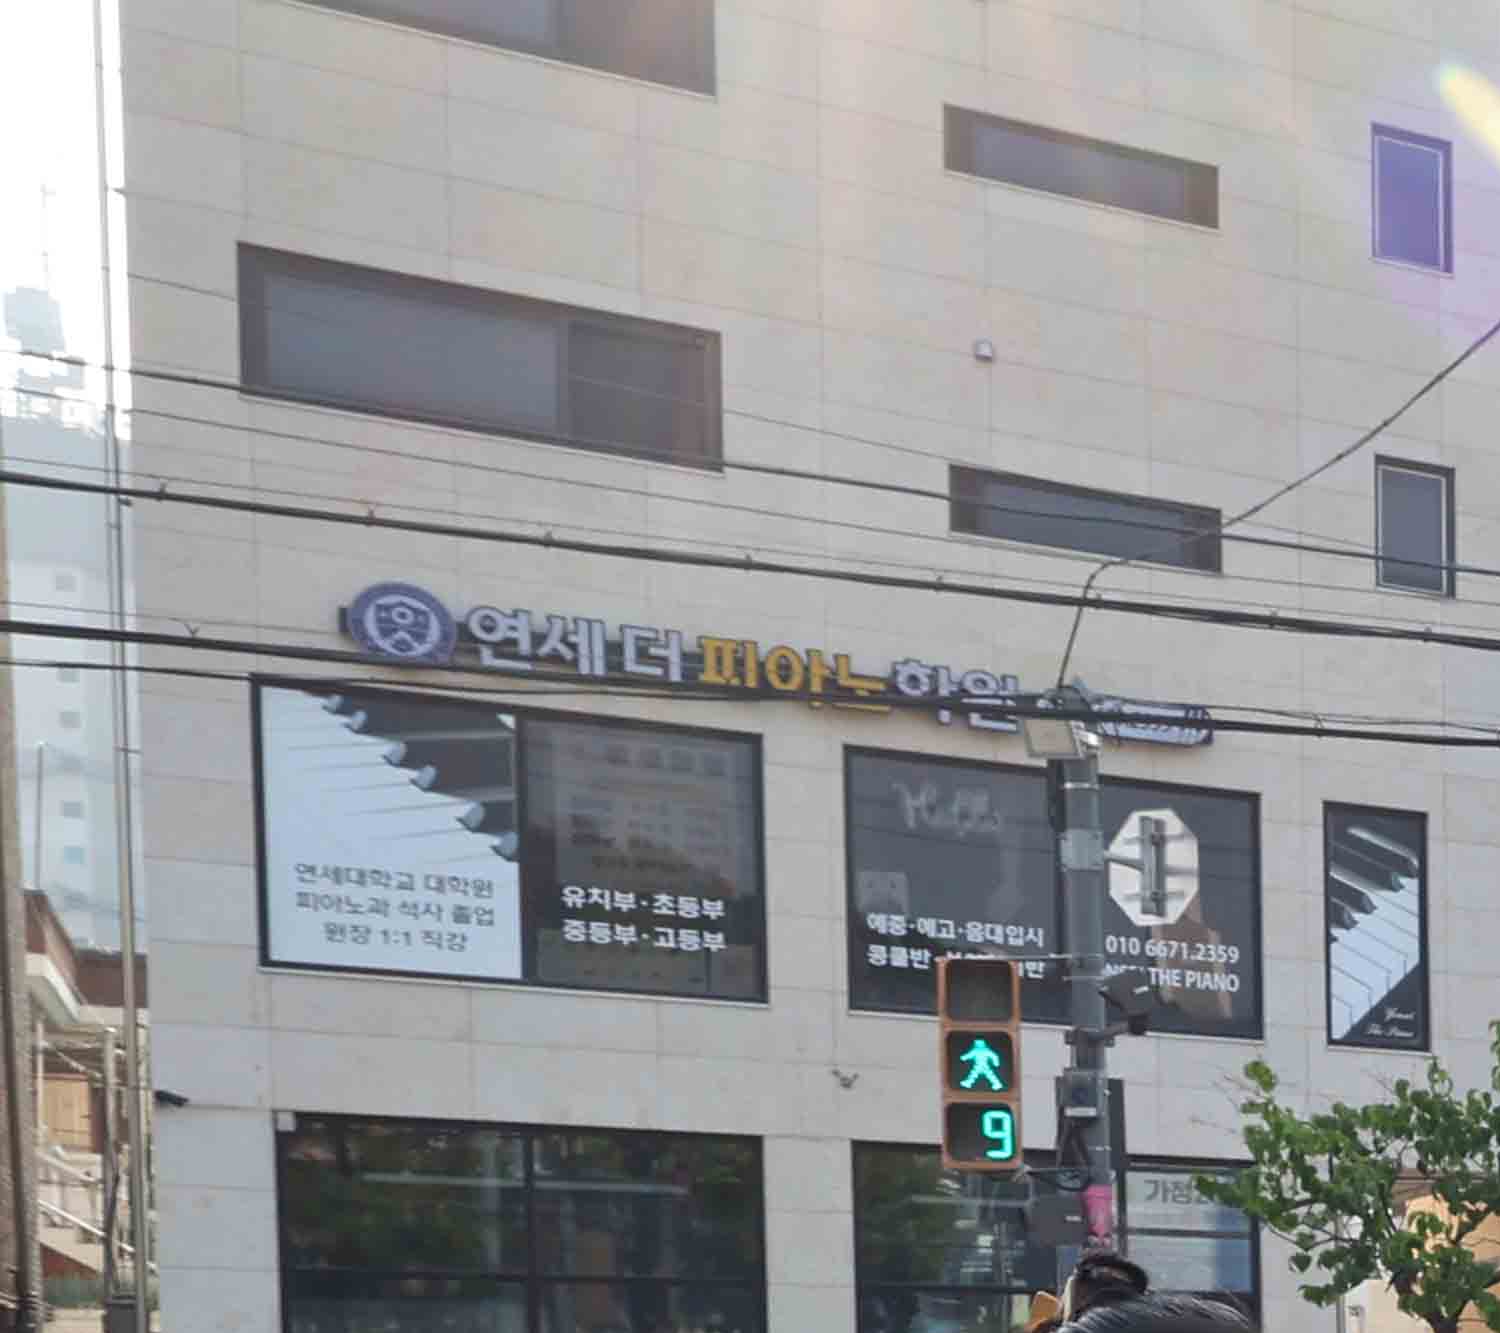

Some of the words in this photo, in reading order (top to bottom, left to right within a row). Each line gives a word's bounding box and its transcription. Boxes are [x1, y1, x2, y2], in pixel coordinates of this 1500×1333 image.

[465, 604, 607, 678] 연세
[621, 622, 685, 684] 더
[696, 633, 894, 713] 피아노
[293, 861, 416, 892] 연세대학교
[424, 872, 496, 899] 대학원
[294, 891, 391, 924] 피아노과
[322, 920, 371, 945] 원장
[1104, 934, 1142, 956] 010
[1144, 938, 1240, 964] 6671.2359
[1148, 962, 1181, 989] THE
[1185, 967, 1240, 992] PIANO
[981, 1109, 1015, 1161] 9
